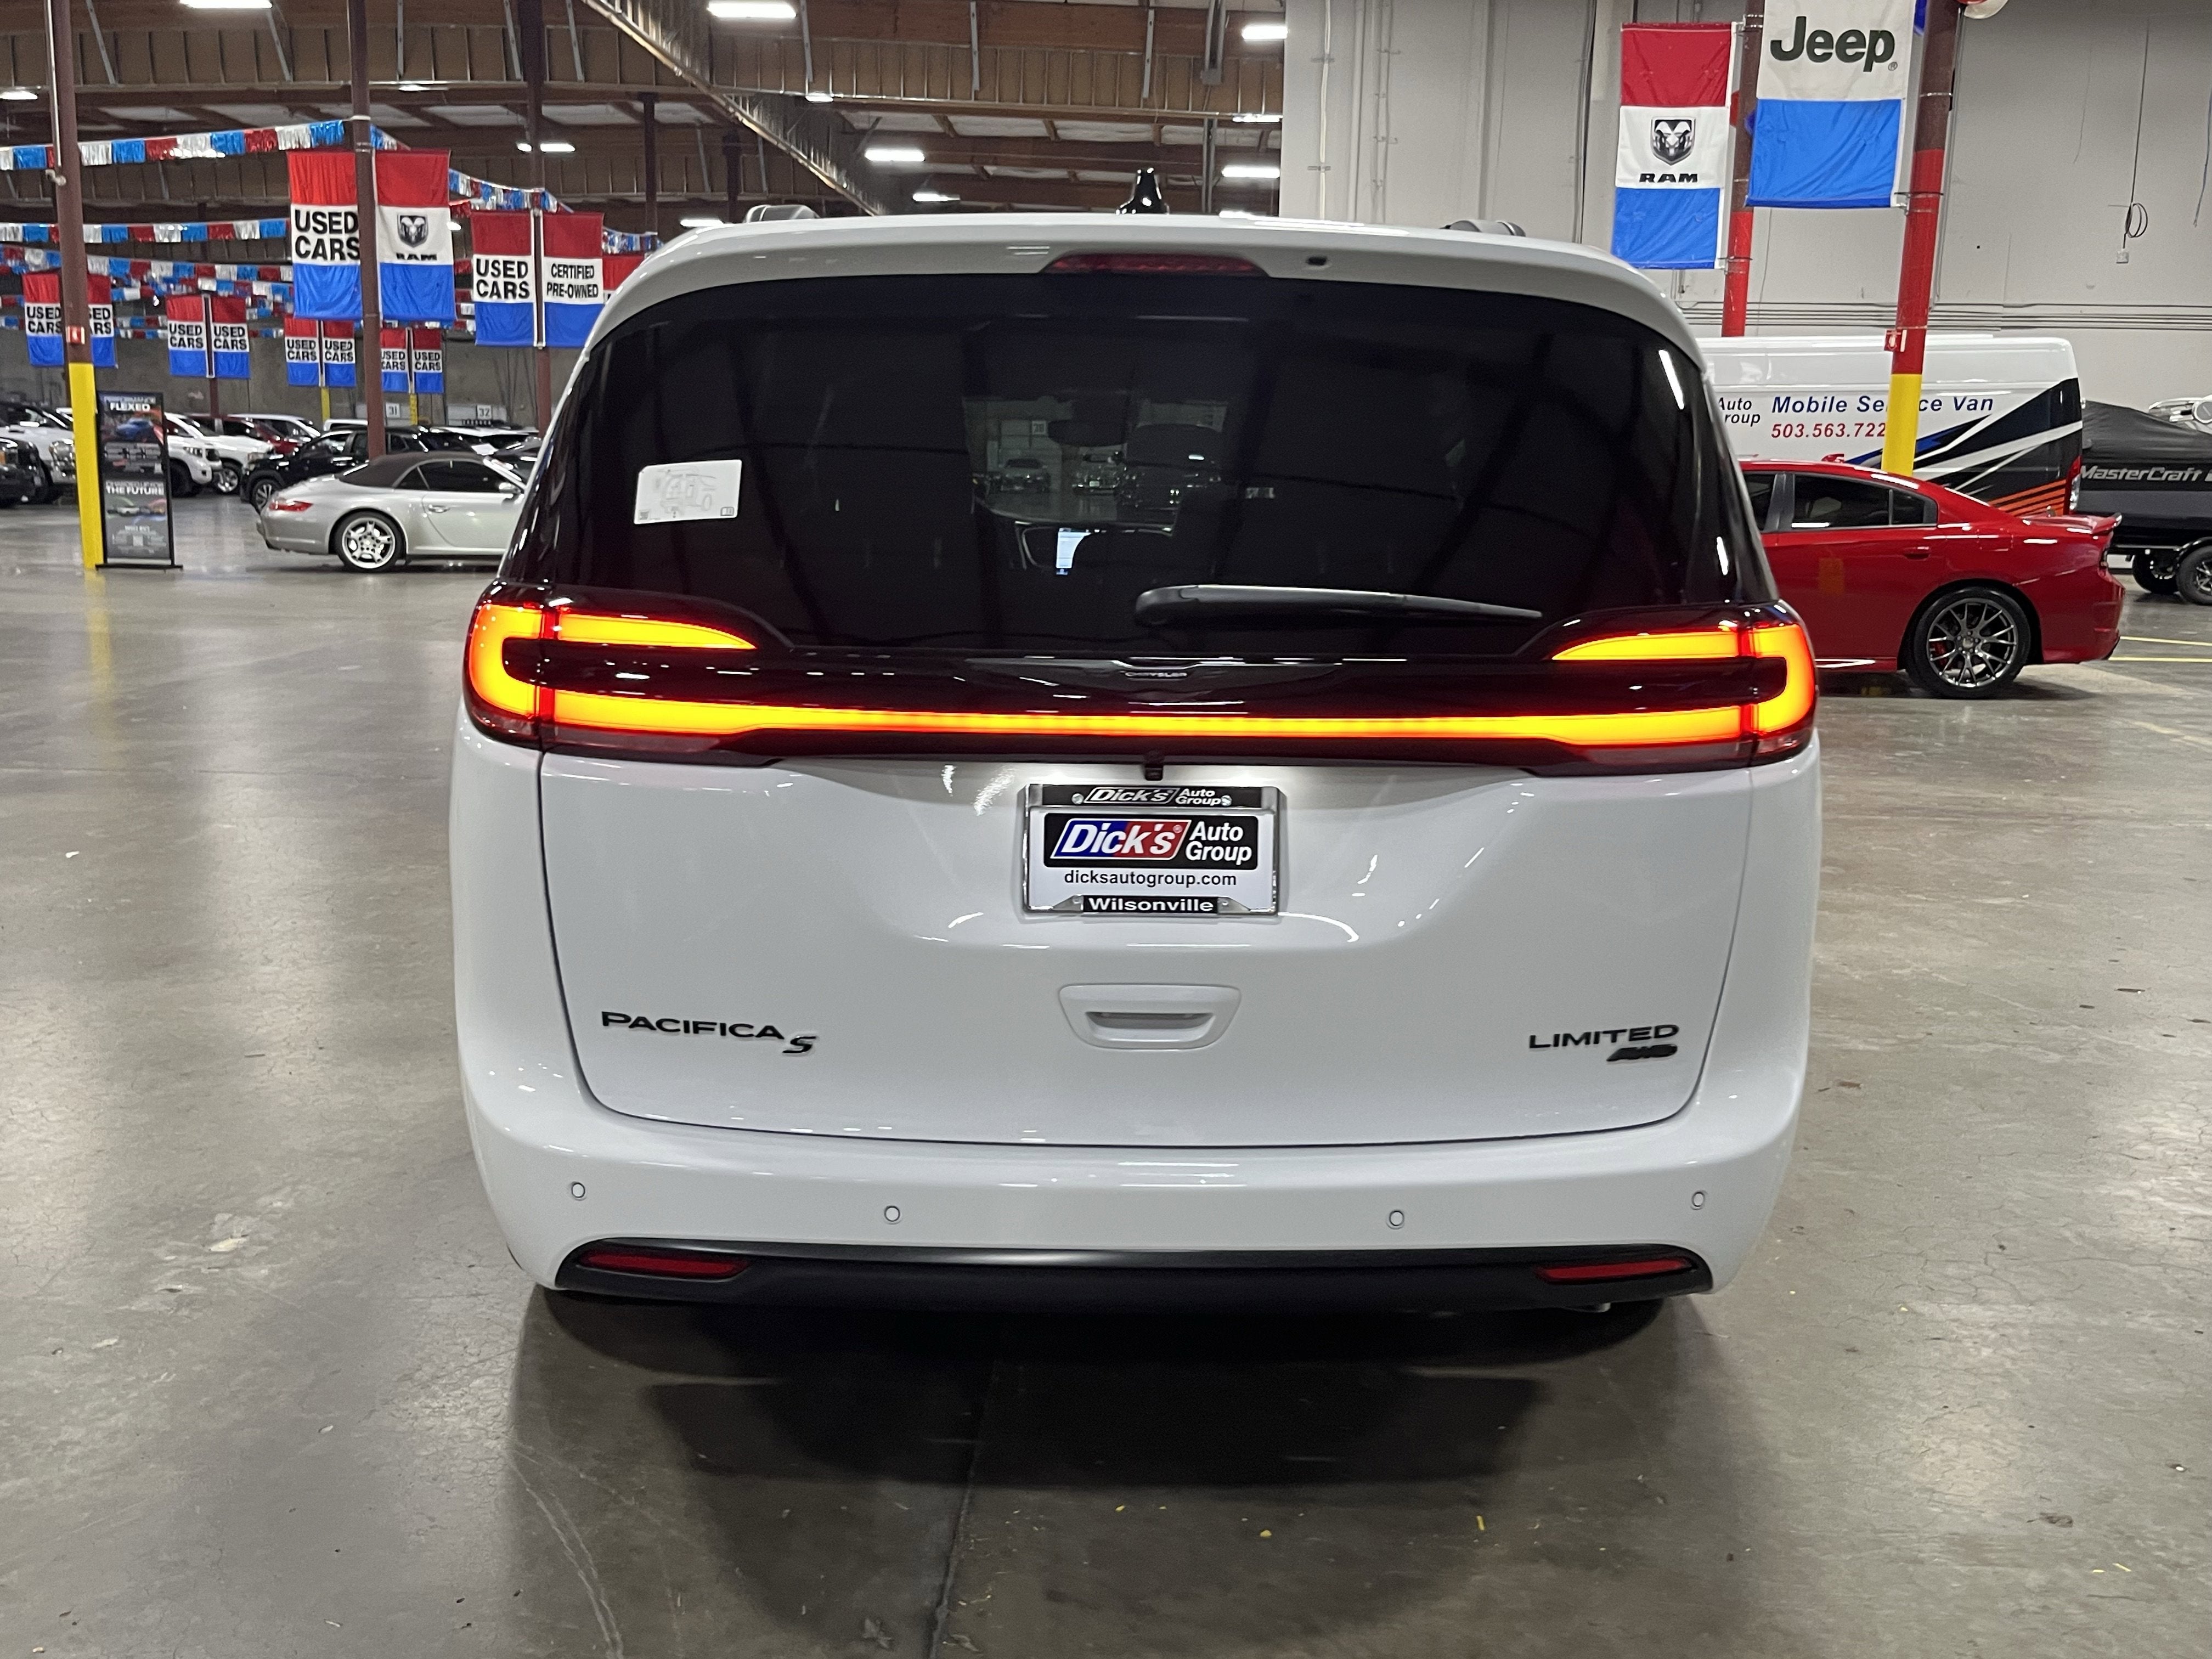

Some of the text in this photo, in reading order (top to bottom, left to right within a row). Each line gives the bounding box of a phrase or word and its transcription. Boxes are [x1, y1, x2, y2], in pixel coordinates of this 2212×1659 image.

[1770, 16, 1895, 72] Jeep
[1639, 173, 1698, 183] RAM
[295, 210, 359, 234] USED
[295, 235, 360, 261] CARS
[396, 252, 437, 261] RAM
[476, 258, 529, 279] USED
[551, 263, 594, 279] CERTIFIED
[476, 279, 530, 299] CARS
[547, 282, 599, 298] PRE-OWNED
[27, 306, 61, 319] USED
[89, 307, 111, 320] ED
[28, 321, 61, 334] CARS
[170, 323, 202, 336] USED
[214, 326, 245, 337] USED
[170, 336, 204, 348] CARS
[214, 338, 246, 350] CARS
[287, 339, 316, 349] USED
[325, 340, 352, 351] USED
[287, 351, 317, 361] CARS
[325, 352, 354, 362] CARS
[415, 352, 441, 360] USED
[415, 362, 441, 370] CARS
[1719, 397, 1752, 410] Auto
[1771, 395, 1994, 413] Mobile Sece Van
[479, 408, 490, 417] 32
[1724, 414, 1760, 427] roup
[1771, 422, 1886, 438] 503.563.722
[2081, 465, 2203, 481] MasterCraft
[1090, 789, 1169, 802] Dick's
[1180, 788, 1215, 797] Auto
[1175, 796, 1221, 806] Group
[1189, 821, 1244, 842] Auto
[1059, 823, 1172, 854] Dick's
[1185, 840, 1252, 865] Group
[1064, 870, 1237, 888] dicksautogroup.com
[1088, 898, 1214, 912] Wilsonville
[601, 1011, 817, 1053] PACIFICA S
[1529, 1024, 1679, 1048] LIMITED
